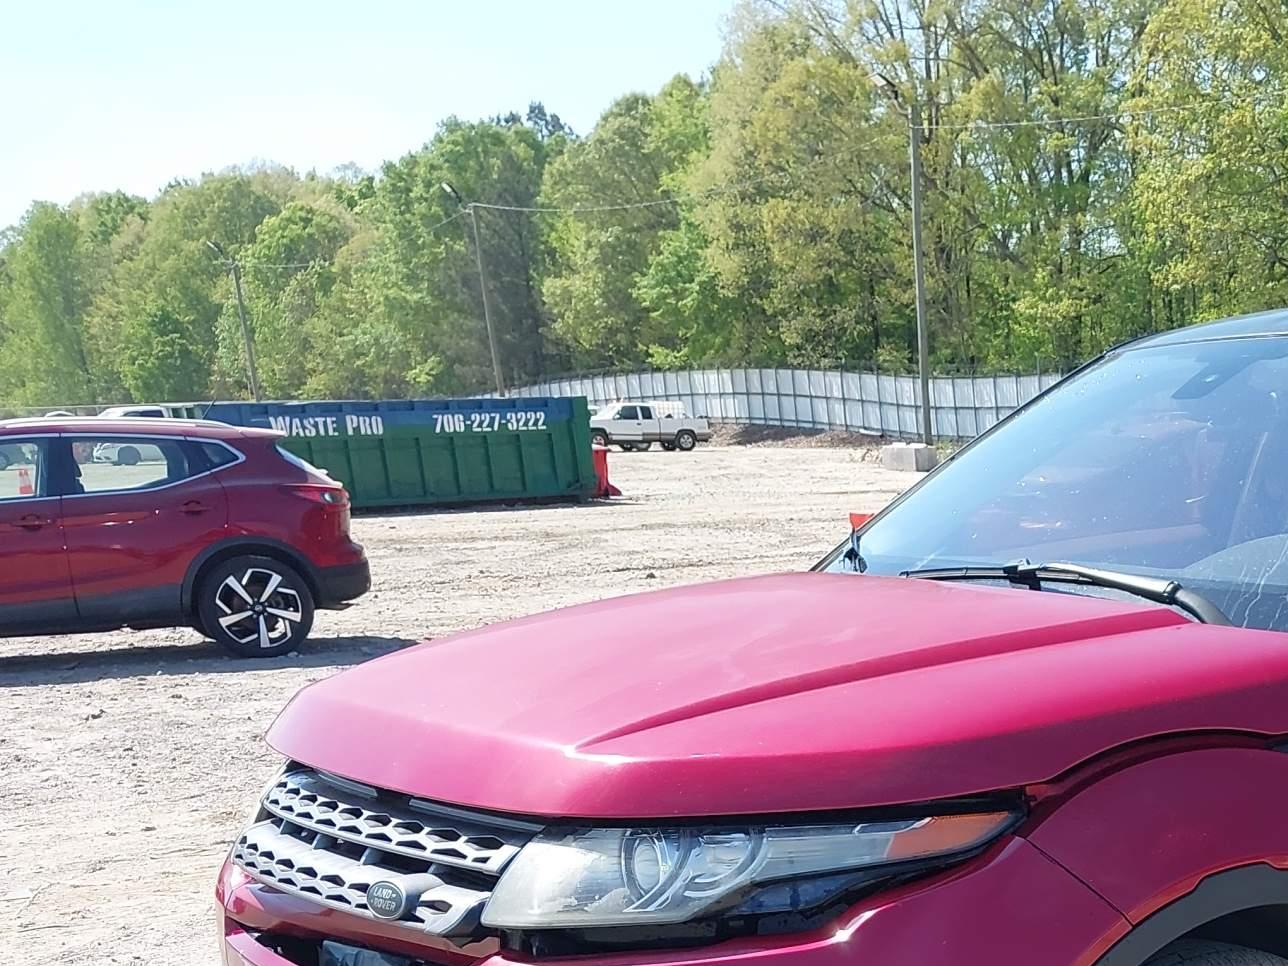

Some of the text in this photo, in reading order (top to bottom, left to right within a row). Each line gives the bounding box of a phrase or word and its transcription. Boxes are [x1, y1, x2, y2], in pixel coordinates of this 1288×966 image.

[268, 413, 384, 438] WASTE PRO
[431, 411, 547, 434] 706-227-3222
[373, 886, 392, 899] LAND
[373, 898, 396, 911] ROVER
